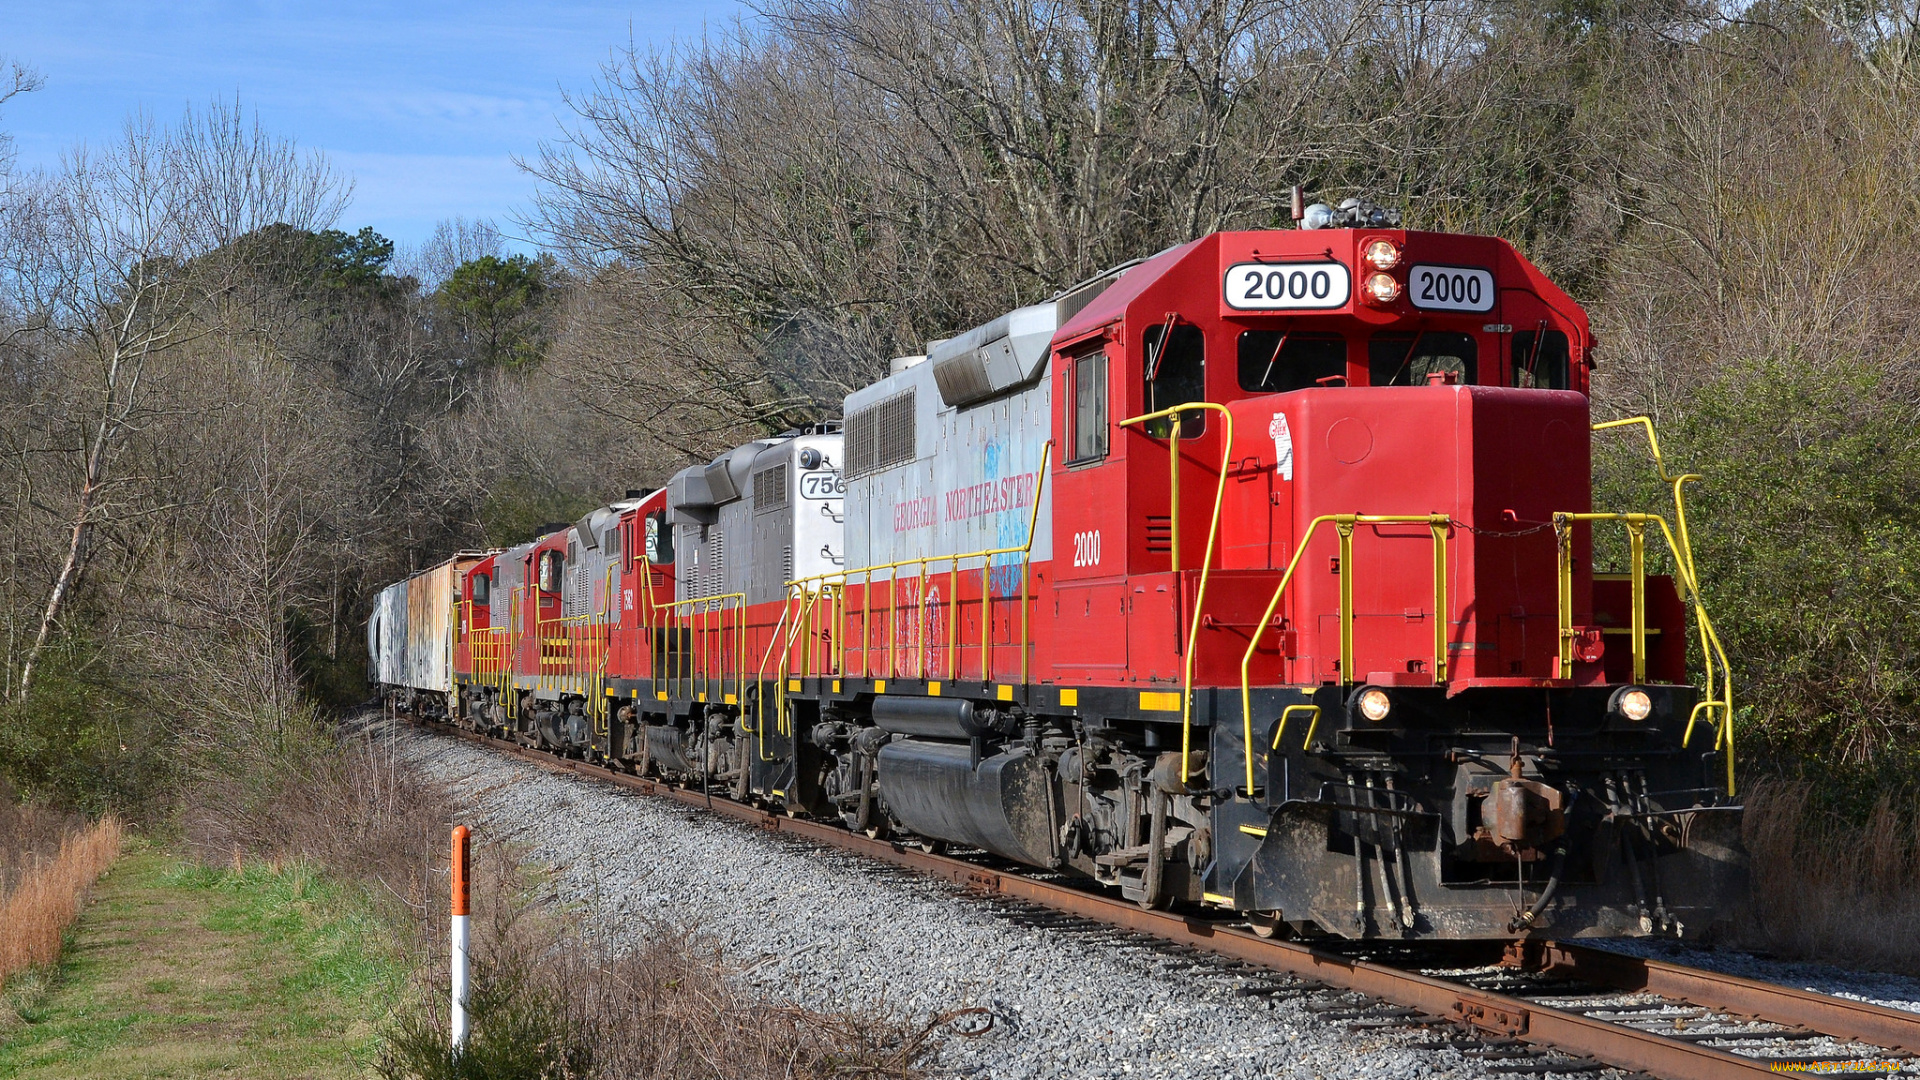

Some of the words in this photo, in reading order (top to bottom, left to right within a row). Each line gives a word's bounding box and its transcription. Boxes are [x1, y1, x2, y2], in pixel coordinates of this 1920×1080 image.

[1244, 270, 1331, 300] 2000
[1420, 271, 1482, 304] 2000
[893, 495, 938, 533] GEORGIA
[1073, 529, 1101, 567] 2000
